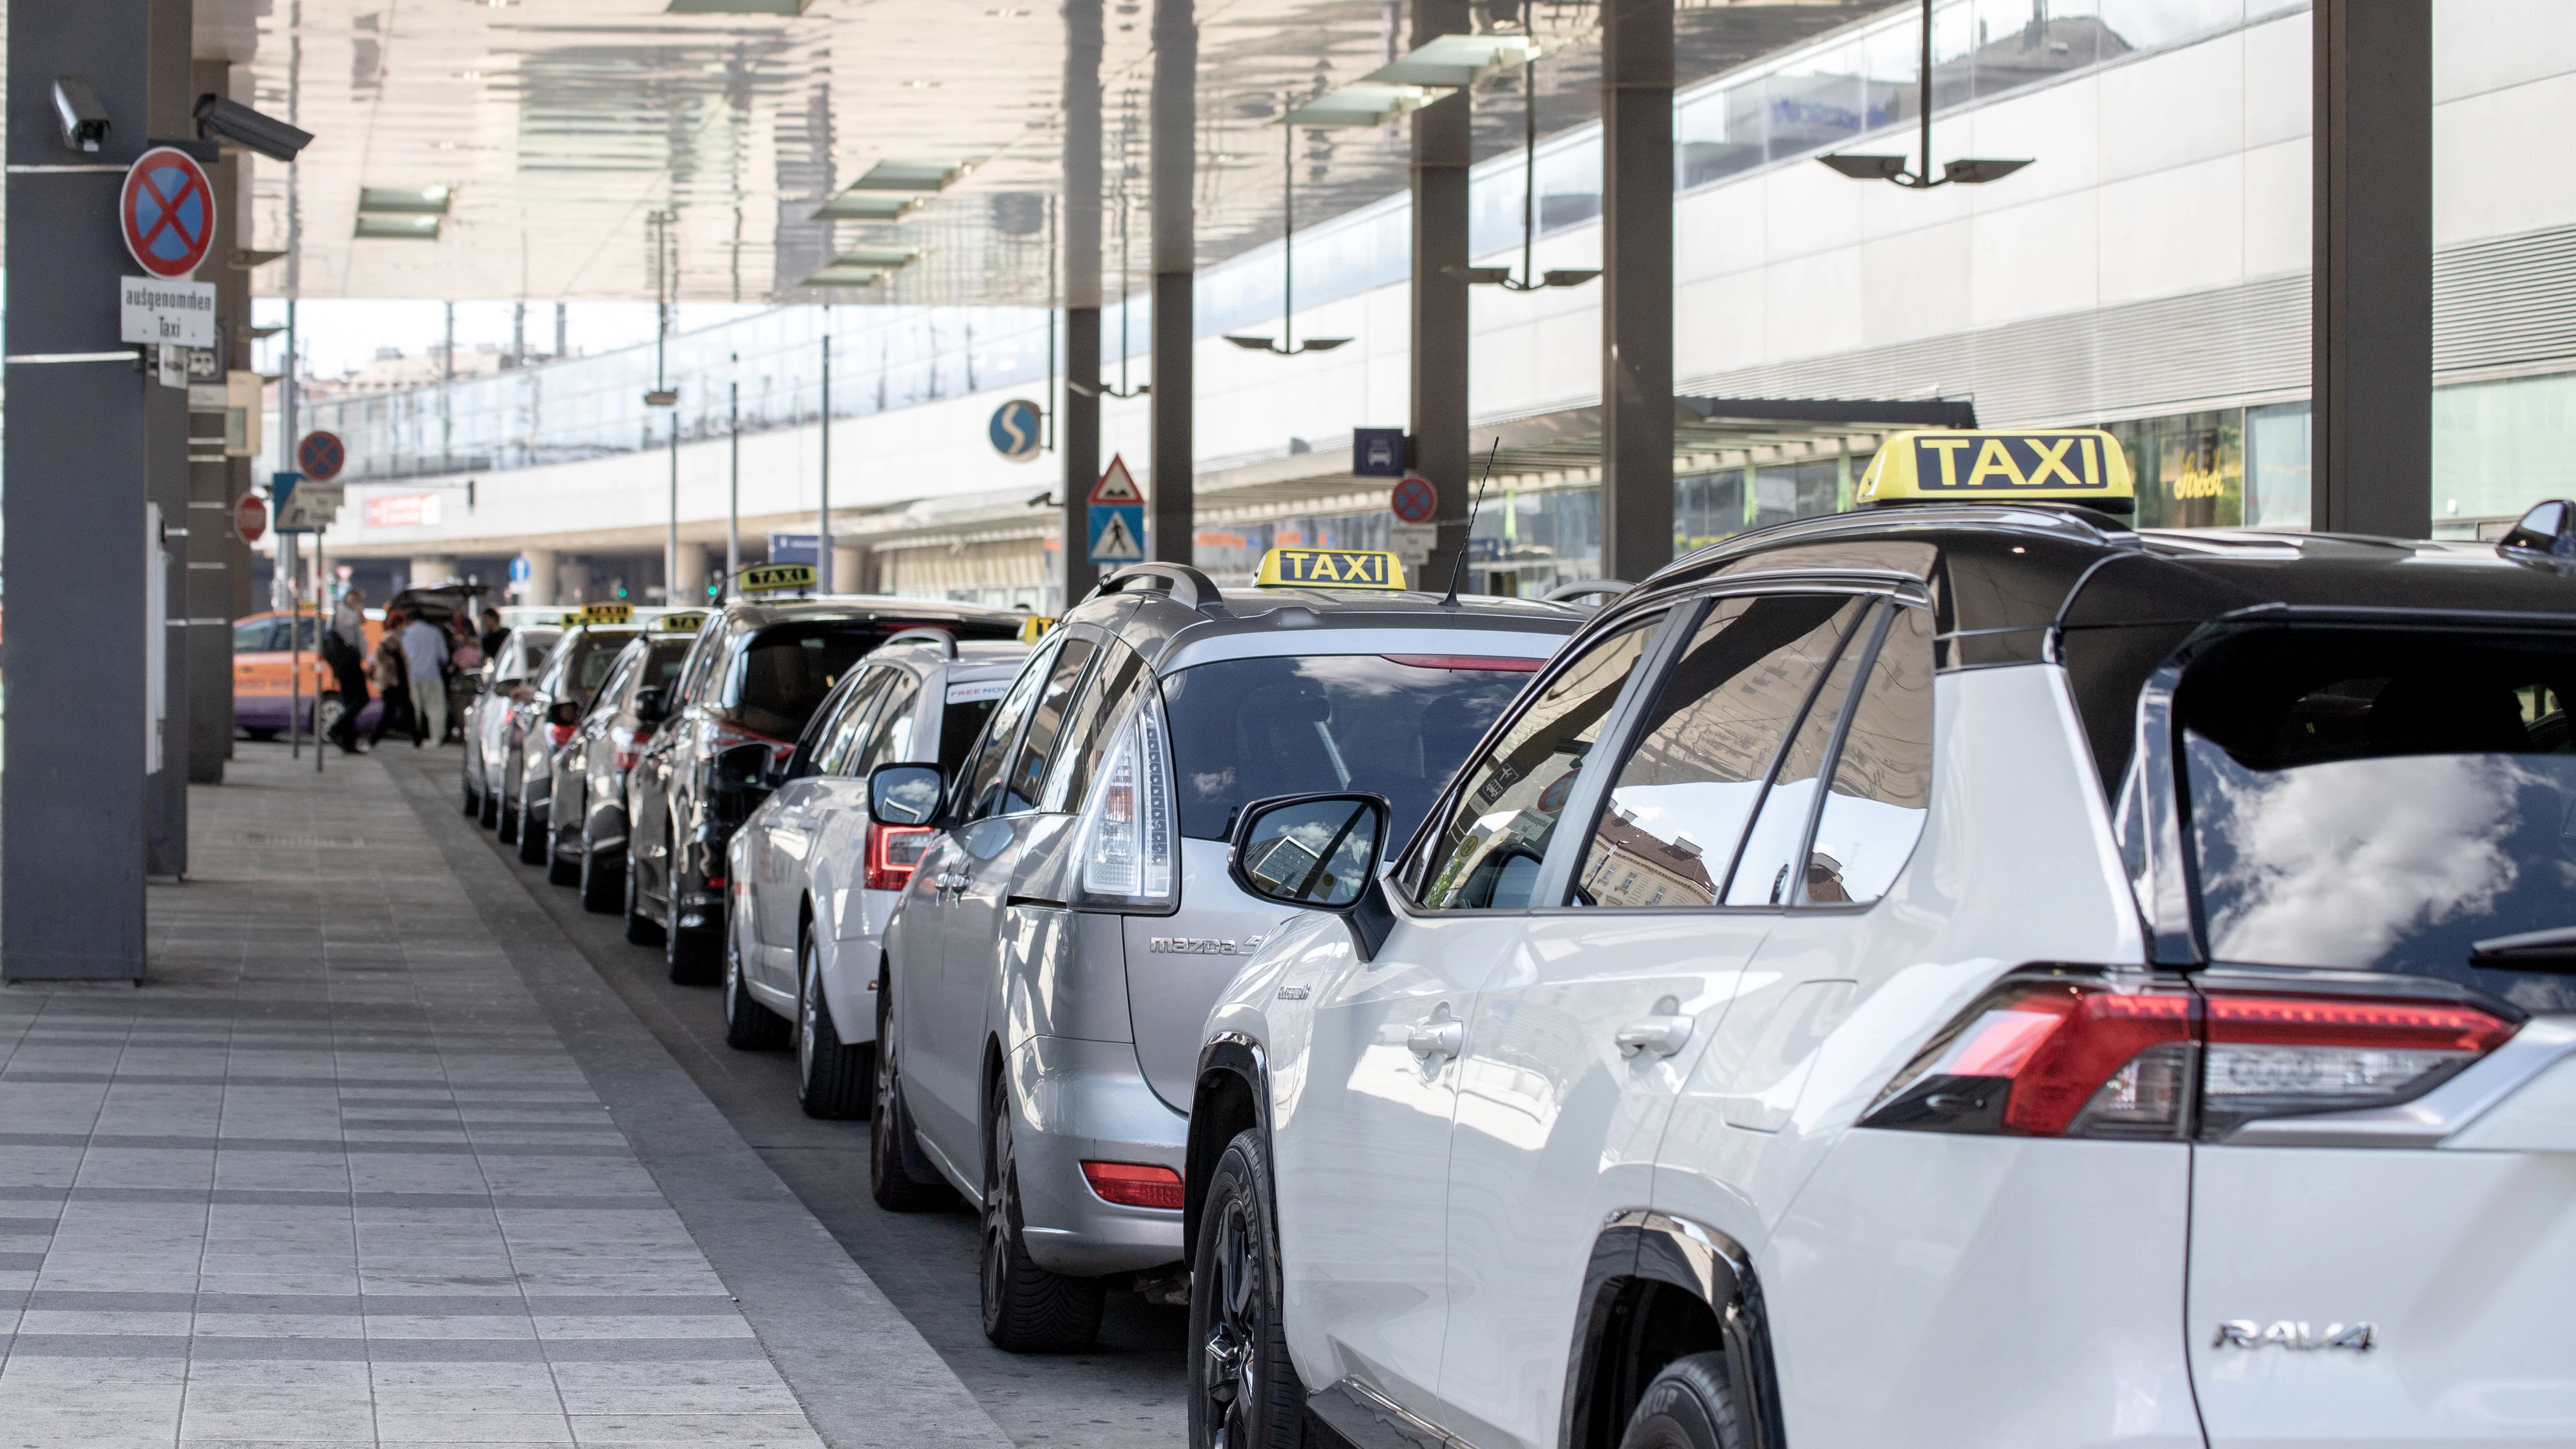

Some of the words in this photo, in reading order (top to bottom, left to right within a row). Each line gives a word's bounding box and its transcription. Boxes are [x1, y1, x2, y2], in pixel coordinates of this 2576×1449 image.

[126, 288, 211, 312] ausgenommen
[158, 316, 180, 338] Taxi
[1920, 439, 2100, 486] TAXI
[754, 568, 808, 583] TAXI
[1286, 553, 1383, 582] TAXI
[672, 617, 705, 629] TAX
[1150, 936, 1236, 955] mazda
[2211, 1320, 2378, 1351] RAV4
